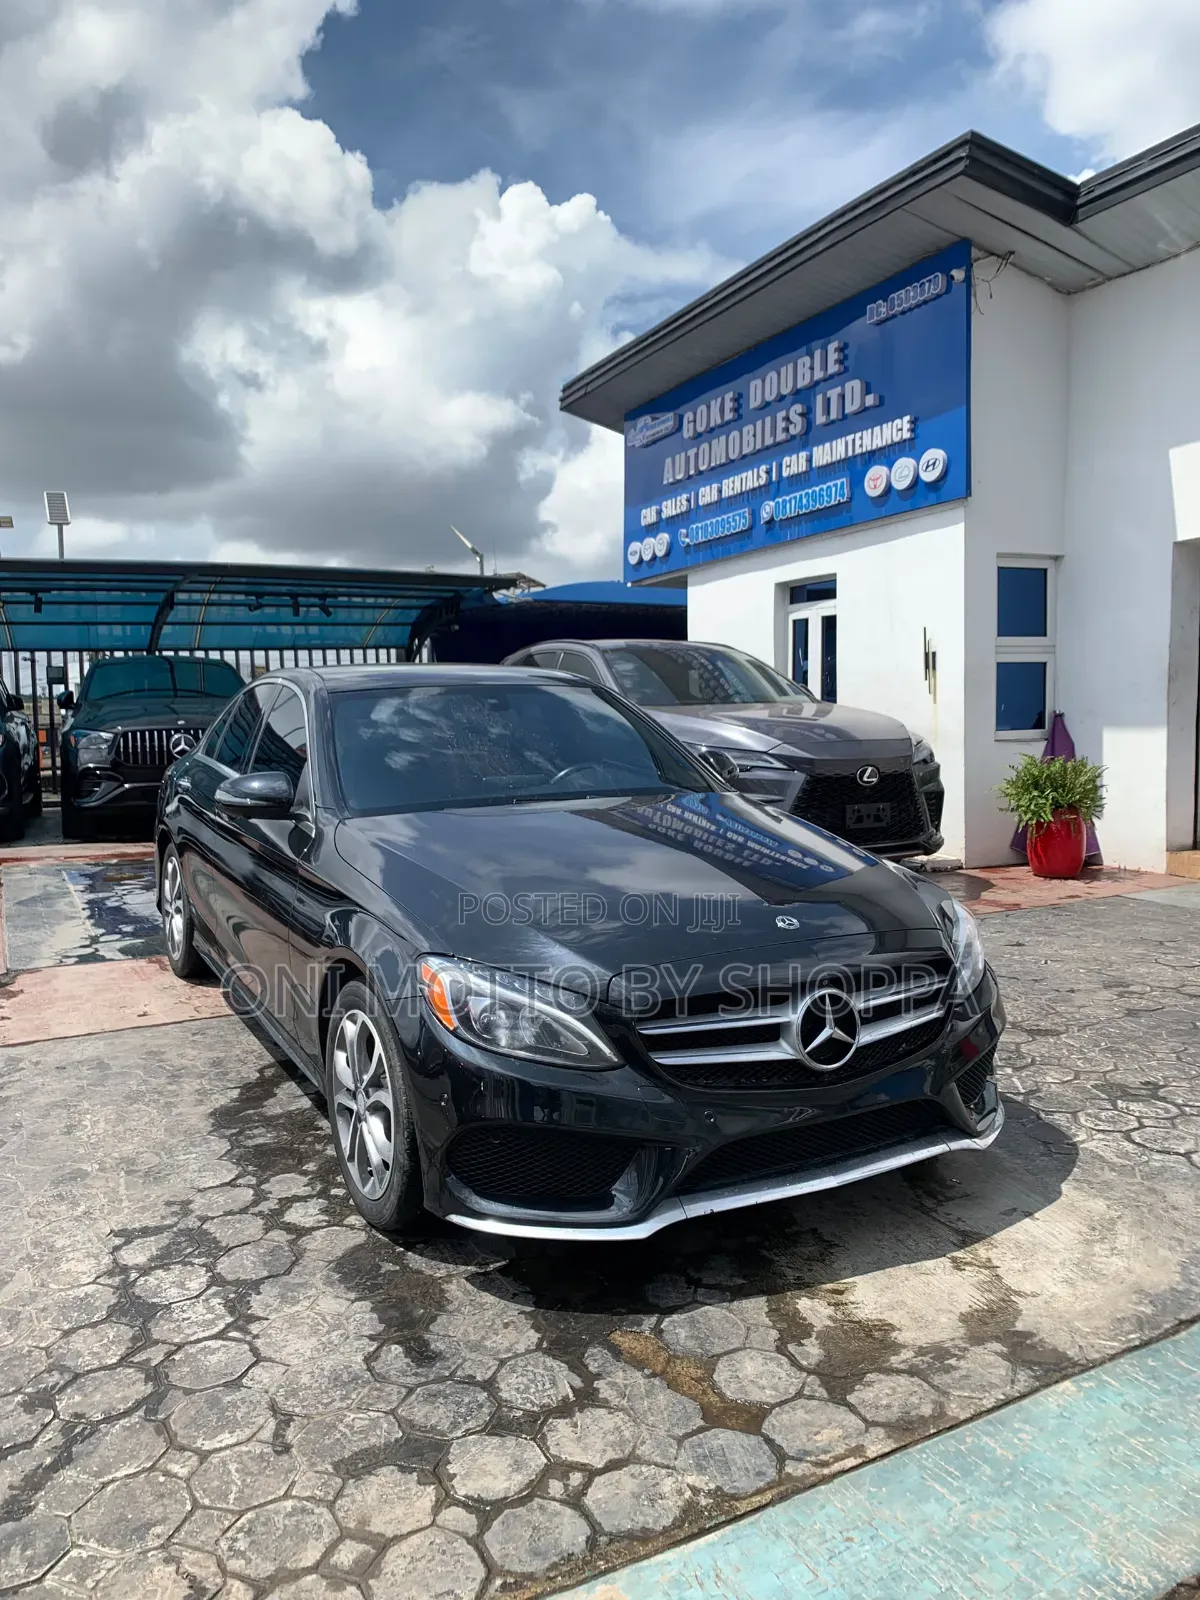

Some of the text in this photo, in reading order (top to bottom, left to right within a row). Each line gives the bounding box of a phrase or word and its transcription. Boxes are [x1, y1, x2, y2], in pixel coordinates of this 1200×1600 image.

[662, 403, 806, 485] AUTOMOBILES
[815, 379, 879, 426] LTD.
[682, 391, 737, 439] GOKE
[749, 340, 843, 410] DOUBLE
[640, 508, 659, 526] CAR
[661, 493, 690, 519] SALES
[698, 483, 721, 506] CAR
[721, 464, 769, 498] RENTALS
[781, 451, 809, 478] CAR
[812, 415, 915, 468] MAINTENANCE
[773, 478, 848, 521] 08174396974
